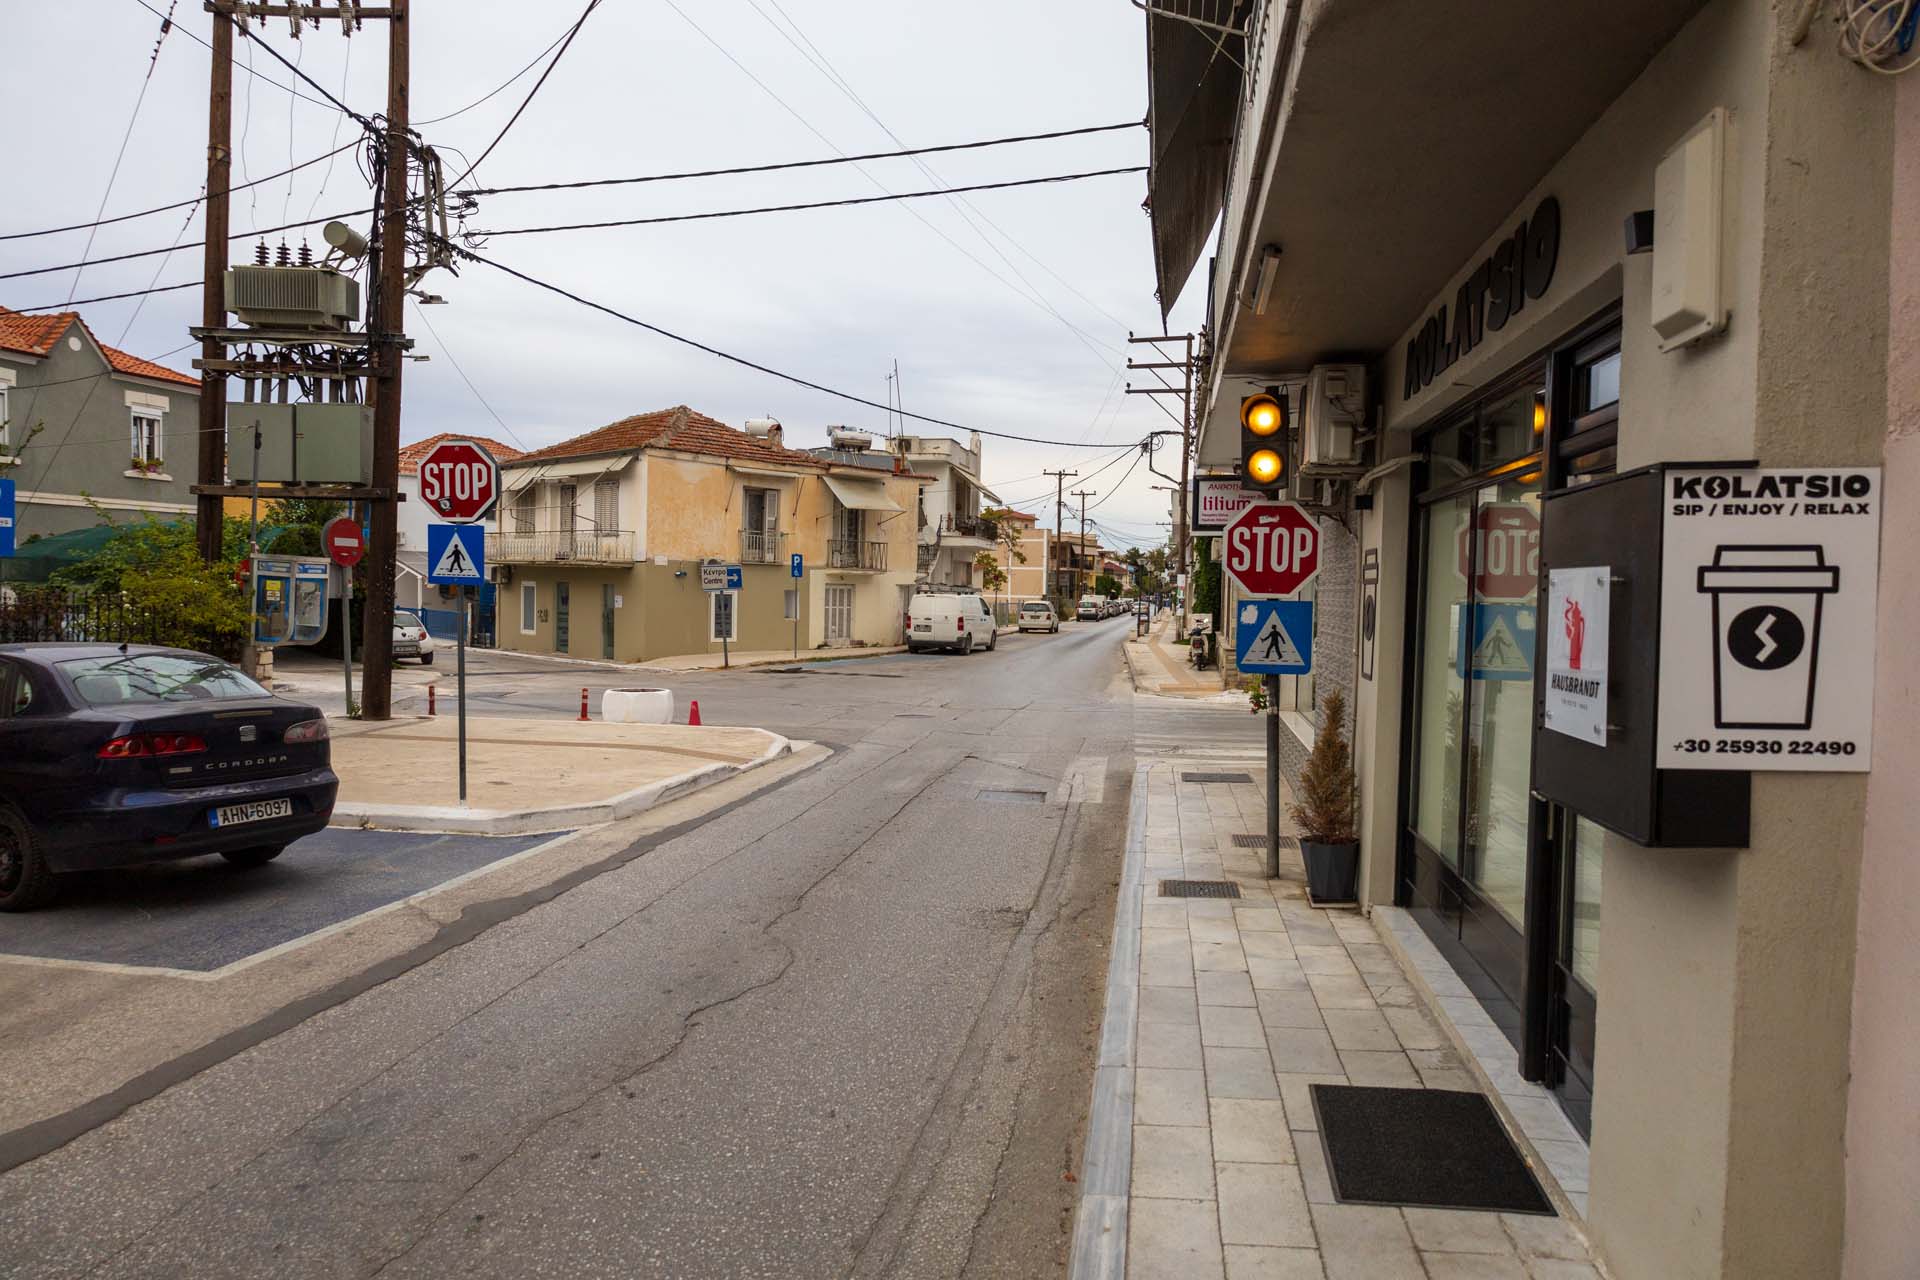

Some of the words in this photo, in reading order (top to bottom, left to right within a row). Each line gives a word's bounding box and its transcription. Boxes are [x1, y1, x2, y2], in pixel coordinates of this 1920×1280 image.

[1404, 195, 1560, 400] KOLATSIO
[424, 462, 488, 500] STOP
[1673, 474, 1871, 499] KOLATSIO
[1203, 495, 1251, 511] lilium
[1673, 503, 1704, 516] SIP
[1722, 503, 1785, 516] ENJOY
[1803, 502, 1870, 515] RELAX
[1231, 526, 1314, 573] STOP
[1551, 672, 1600, 699] HAUSBRANDT
[1673, 739, 1711, 753] +30
[1715, 740, 1783, 754] 25930
[1787, 741, 1857, 755] 22490
